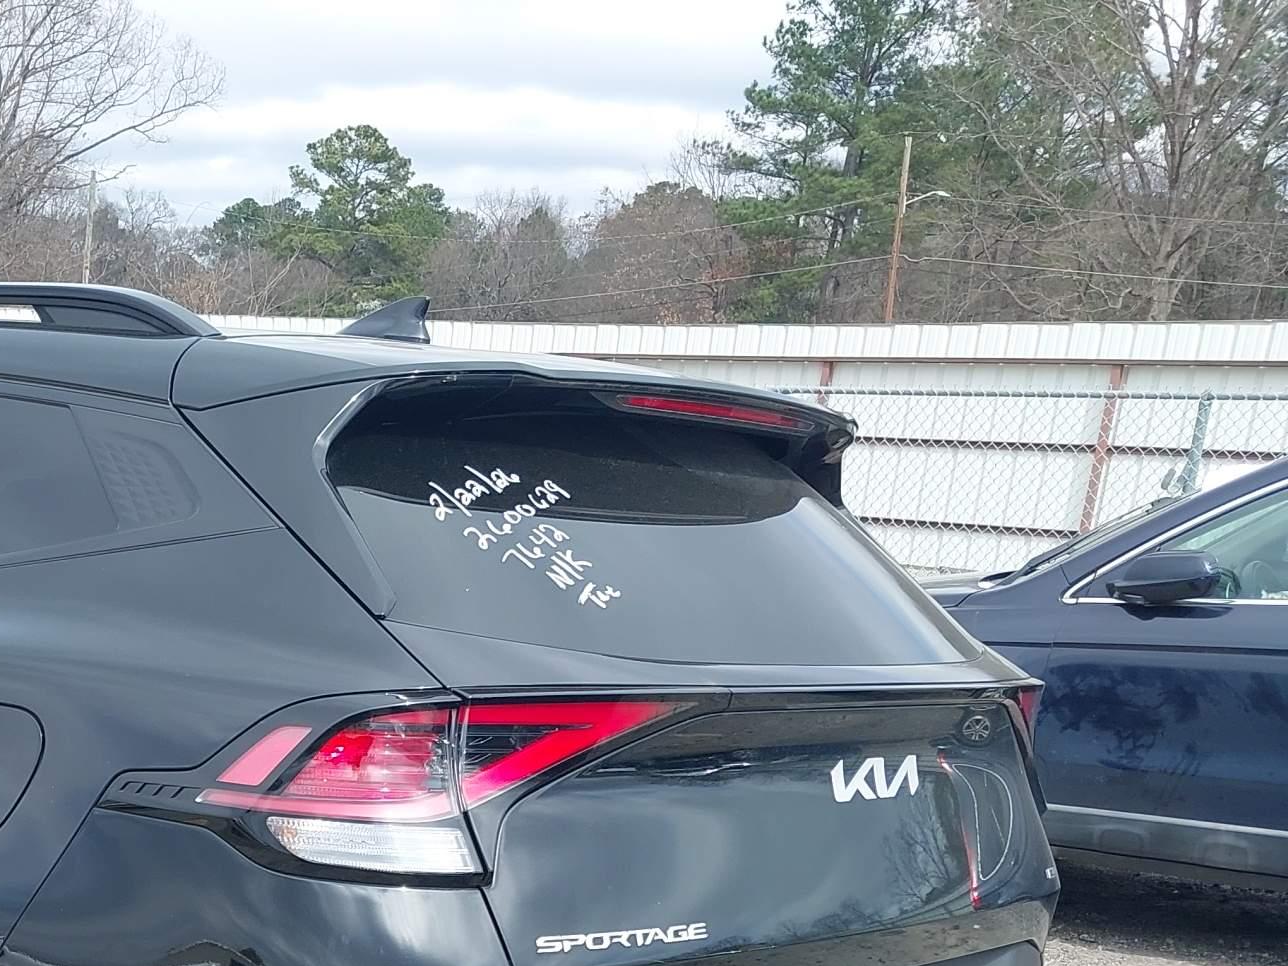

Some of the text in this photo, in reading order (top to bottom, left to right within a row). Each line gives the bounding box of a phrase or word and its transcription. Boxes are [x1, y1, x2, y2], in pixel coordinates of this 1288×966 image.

[501, 523, 570, 569] 7642
[830, 754, 919, 803] KIA
[535, 922, 709, 954] SPORTAGE
